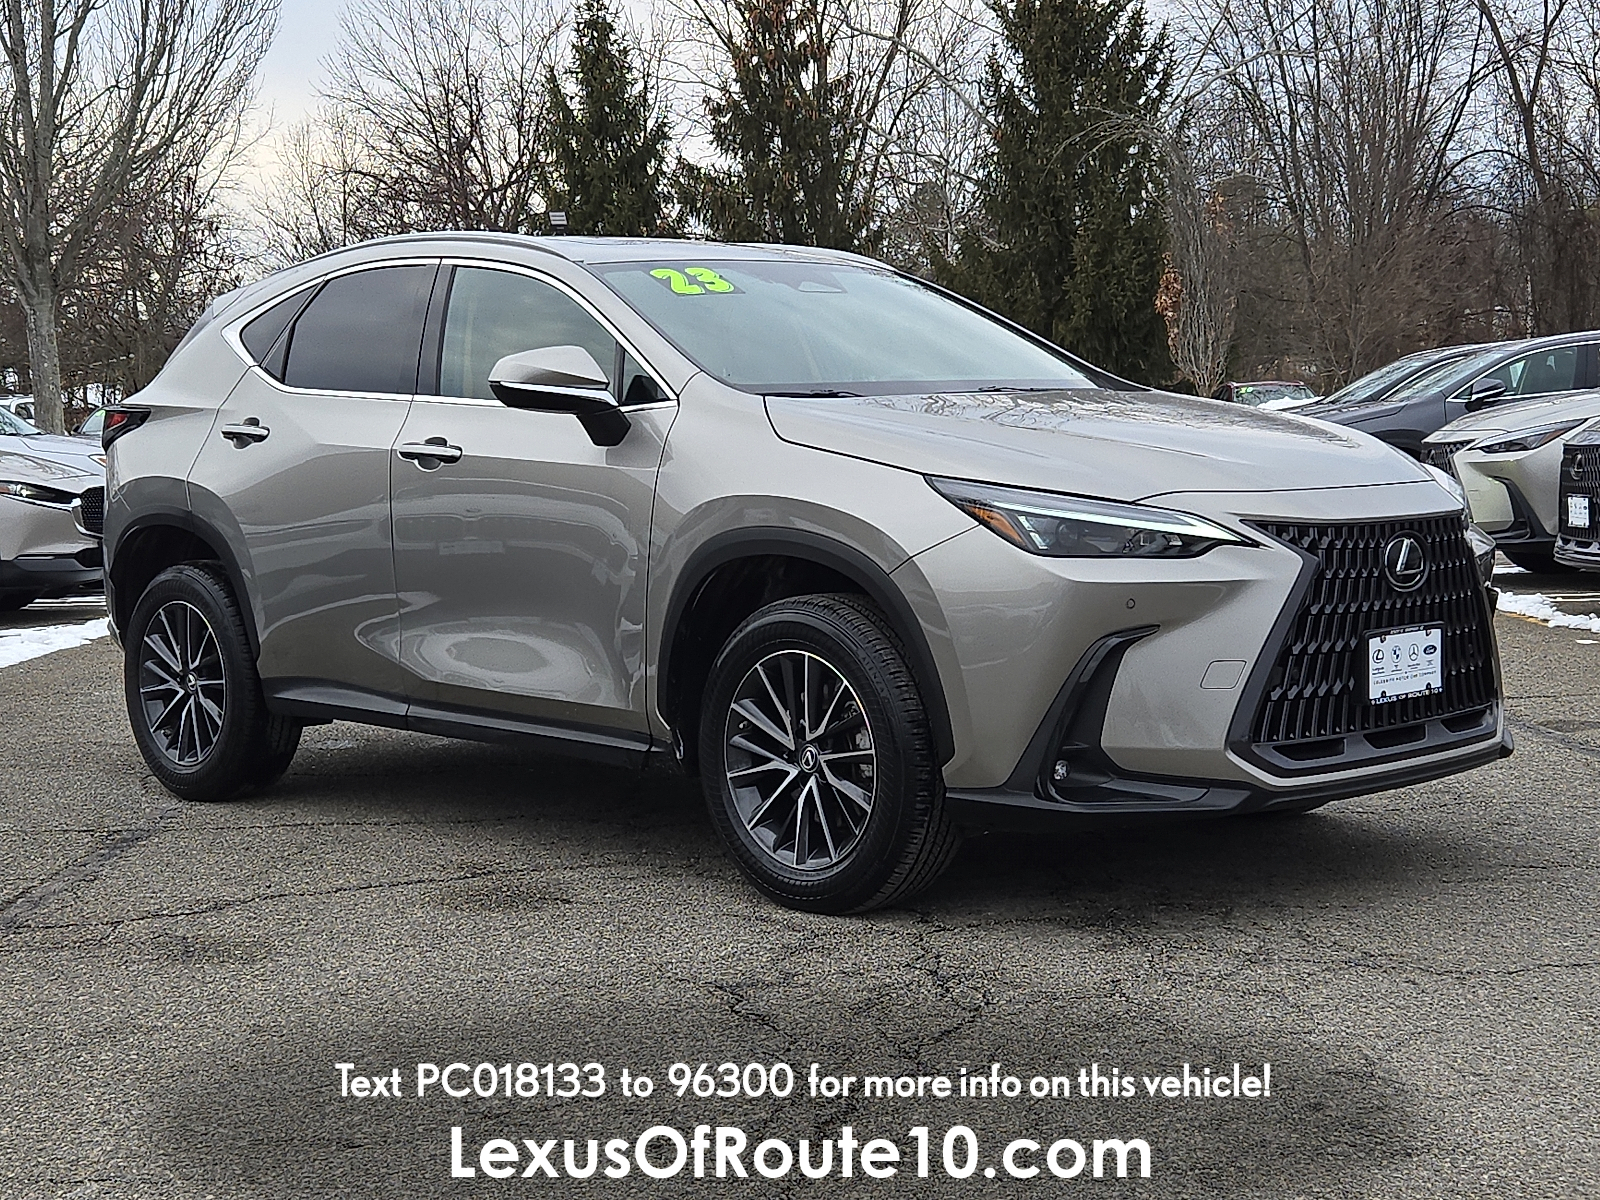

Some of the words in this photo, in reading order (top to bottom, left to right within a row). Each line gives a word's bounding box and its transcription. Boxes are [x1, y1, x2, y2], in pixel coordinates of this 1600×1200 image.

[650, 267, 735, 294] 23
[1375, 696, 1398, 705] LEXUS
[1407, 690, 1430, 699] ROUTE
